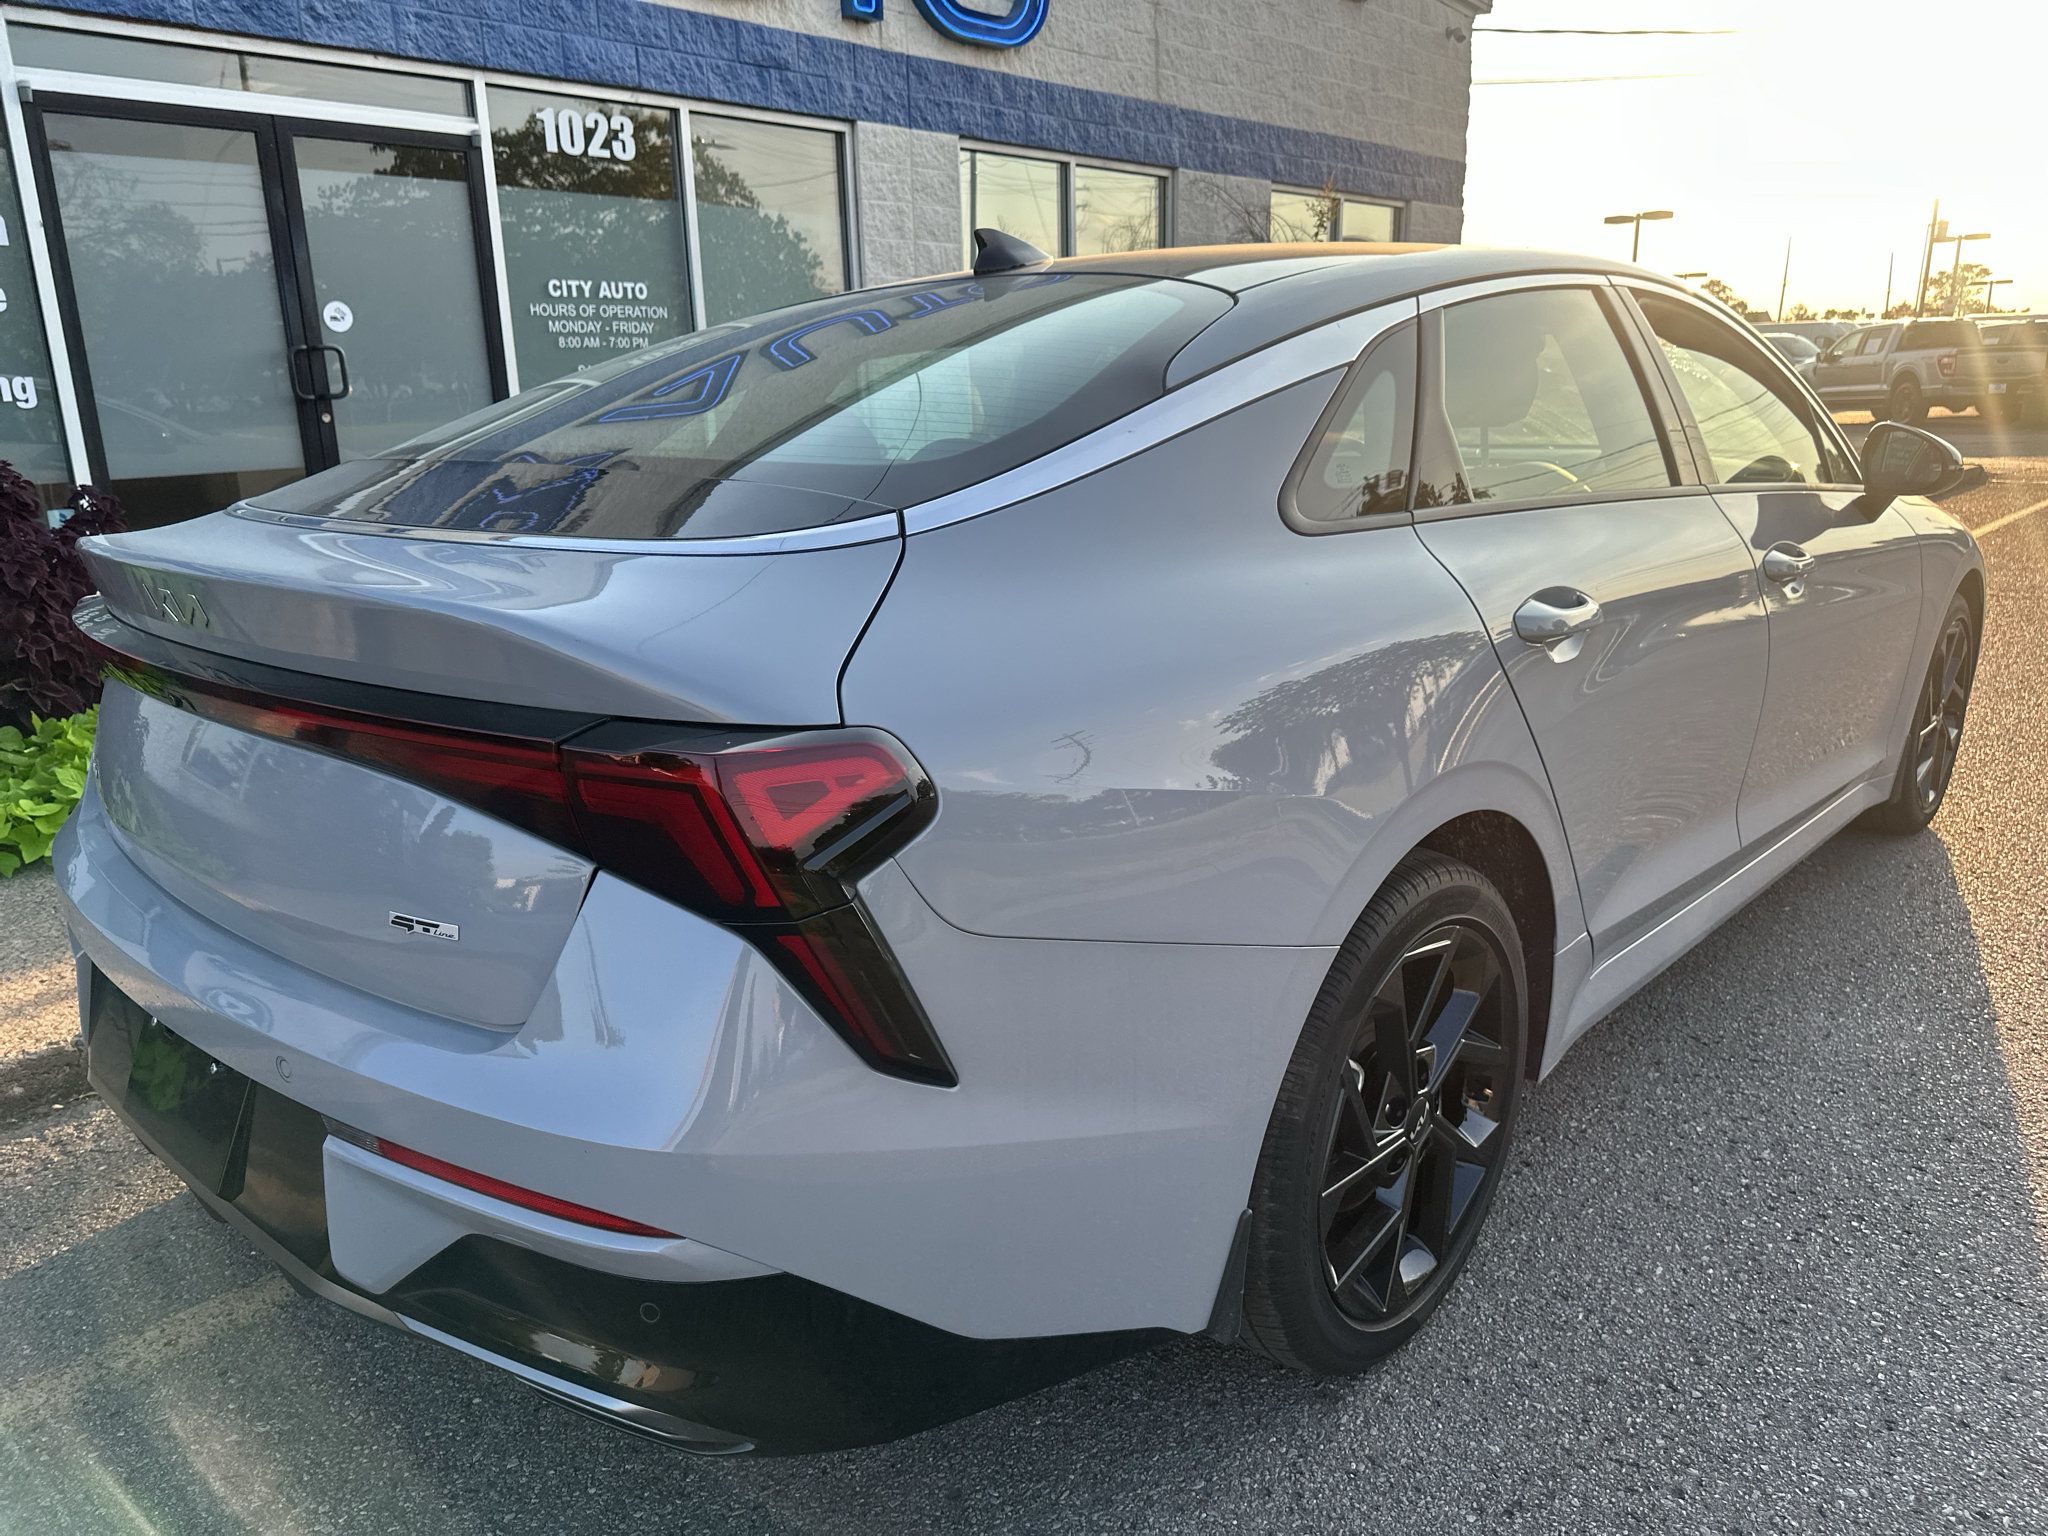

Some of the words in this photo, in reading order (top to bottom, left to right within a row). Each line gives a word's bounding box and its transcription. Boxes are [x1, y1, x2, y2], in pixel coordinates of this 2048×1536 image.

[536, 108, 637, 161] 1023
[548, 279, 593, 298] CITY
[599, 281, 648, 299] AUTO
[530, 303, 576, 317] HOURS
[579, 304, 597, 317] OF
[600, 305, 668, 319] OPERATION
[548, 321, 603, 334] MONDAY
[612, 322, 655, 334] FRIDAY
[558, 337, 582, 349] 8:00
[583, 337, 600, 349] AM
[609, 337, 630, 349] 7:00
[632, 337, 649, 349] PM
[391, 915, 440, 934] GT
